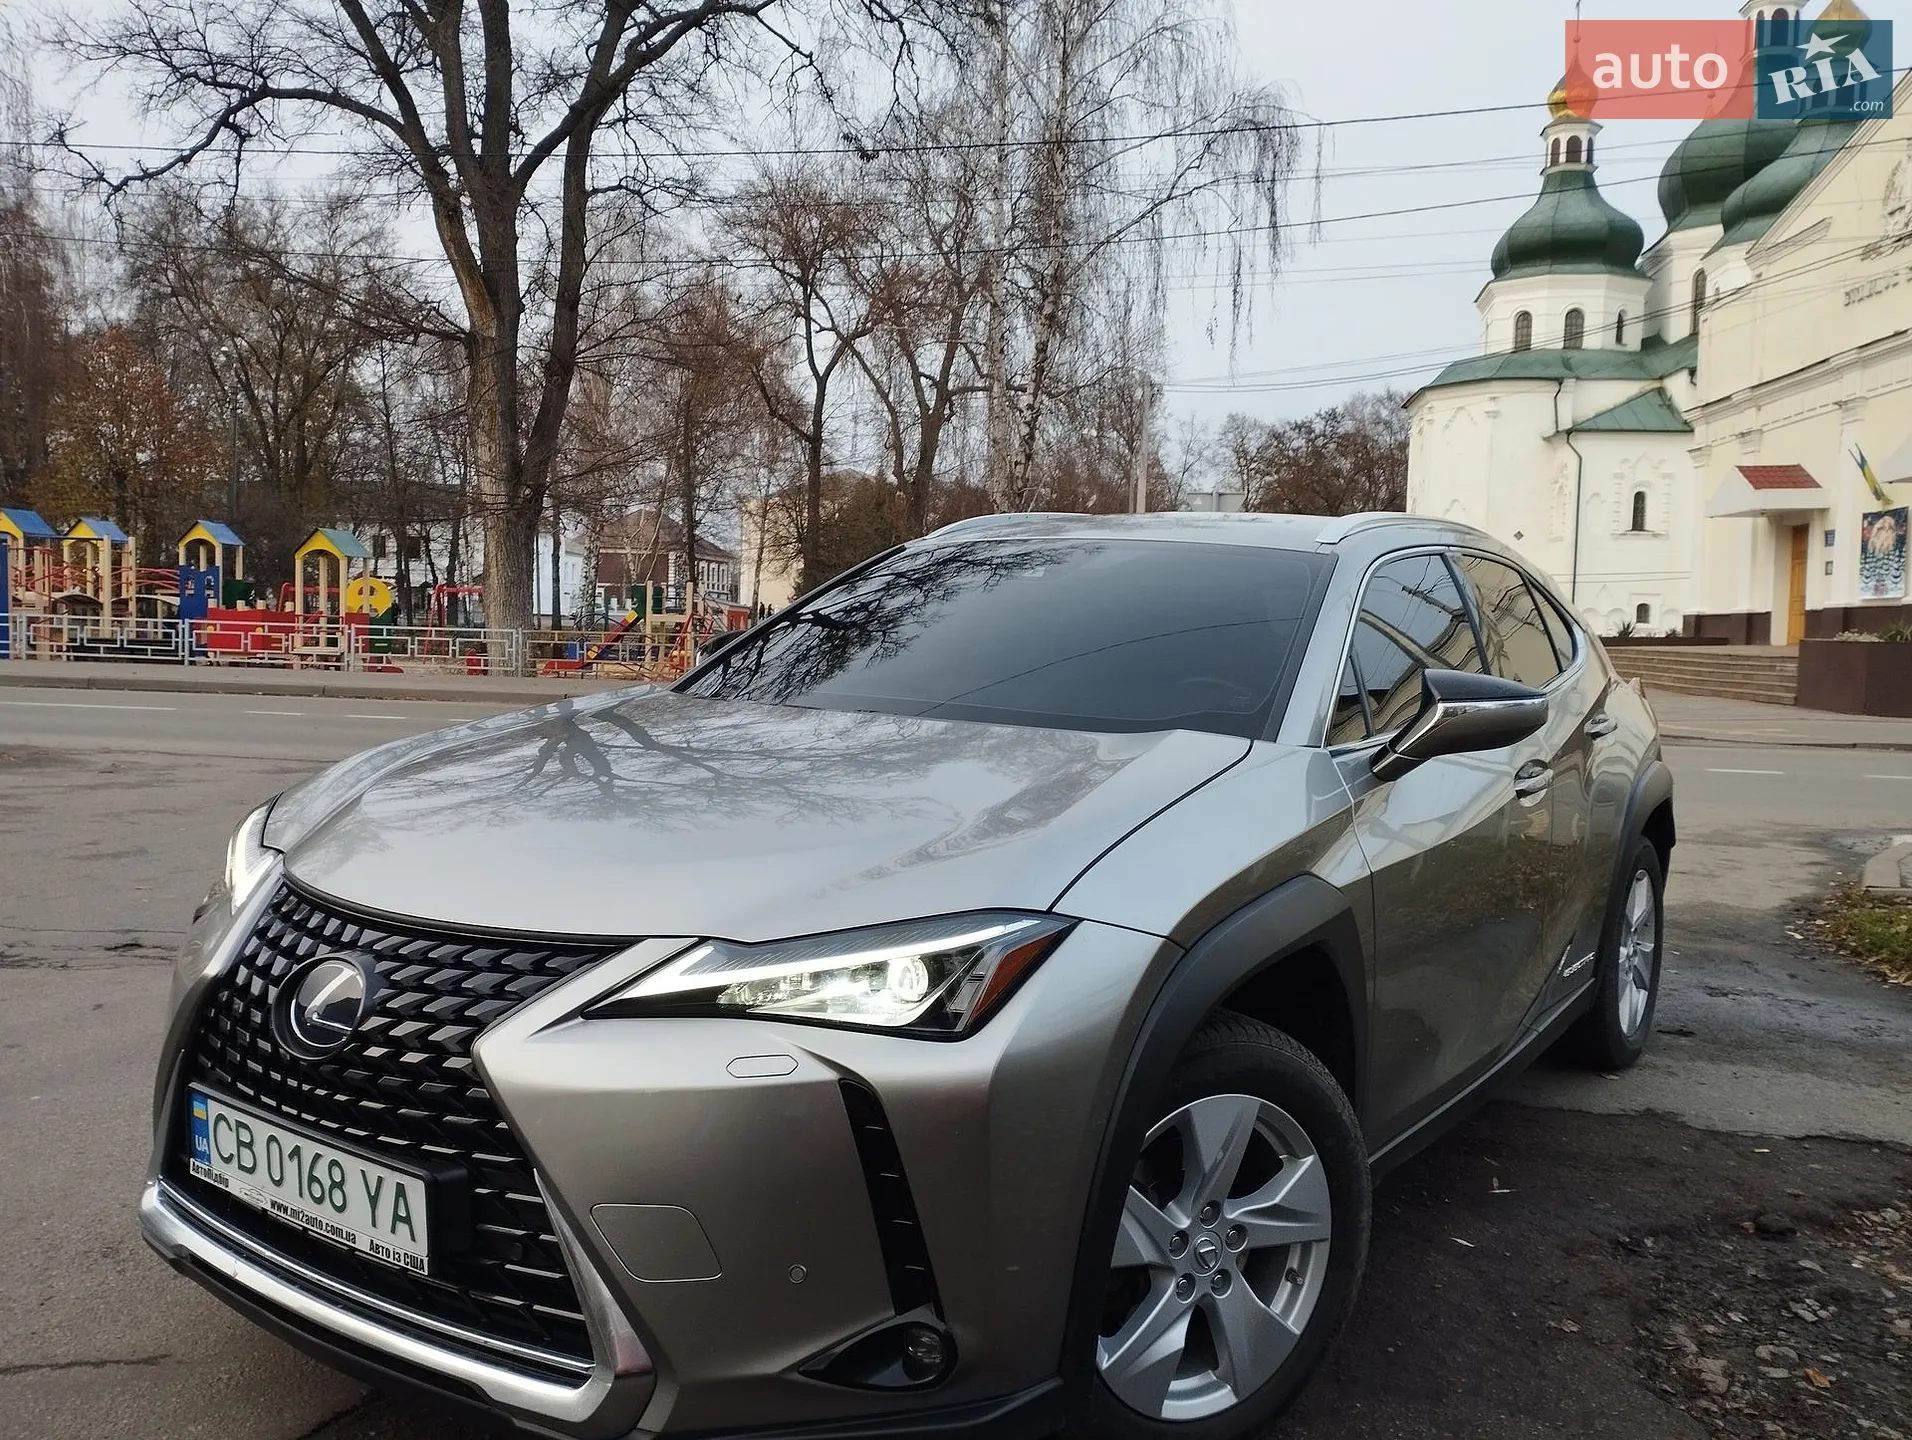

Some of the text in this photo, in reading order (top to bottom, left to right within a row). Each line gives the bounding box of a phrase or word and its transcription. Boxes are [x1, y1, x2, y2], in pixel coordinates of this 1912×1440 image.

[195, 1134, 209, 1154] UA
[213, 1112, 416, 1242] CB 0168 YA
[270, 1198, 357, 1245] www.mi2auto.com.ua
[403, 1252, 426, 1273] США
